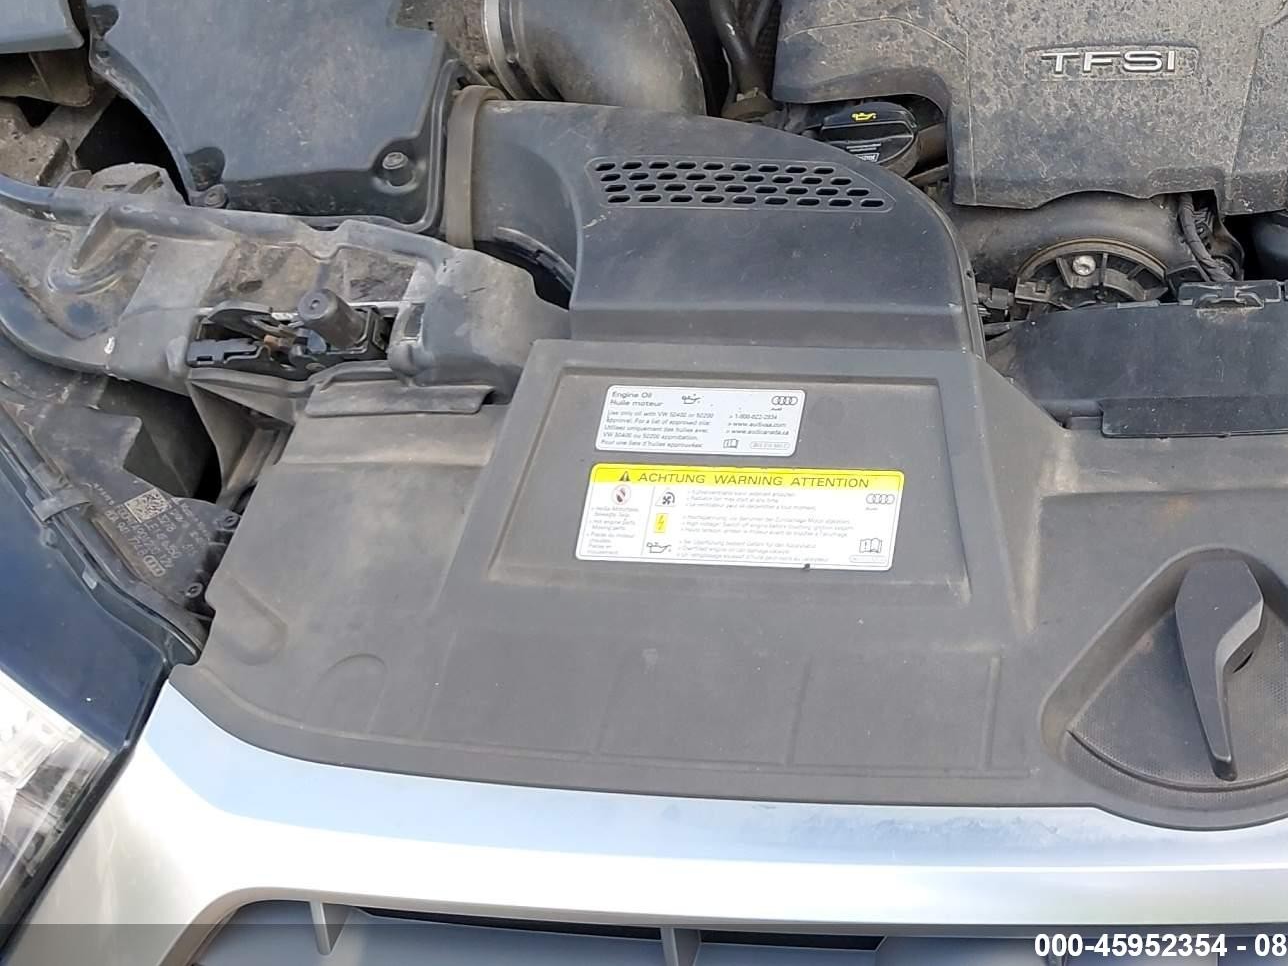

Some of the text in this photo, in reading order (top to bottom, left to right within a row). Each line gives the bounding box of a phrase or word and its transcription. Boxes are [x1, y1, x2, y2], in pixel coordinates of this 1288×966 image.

[1041, 50, 1176, 74] TFSI
[611, 391, 639, 399] Engine
[638, 473, 870, 489] ACHTUNG WARNING ATTENTION
